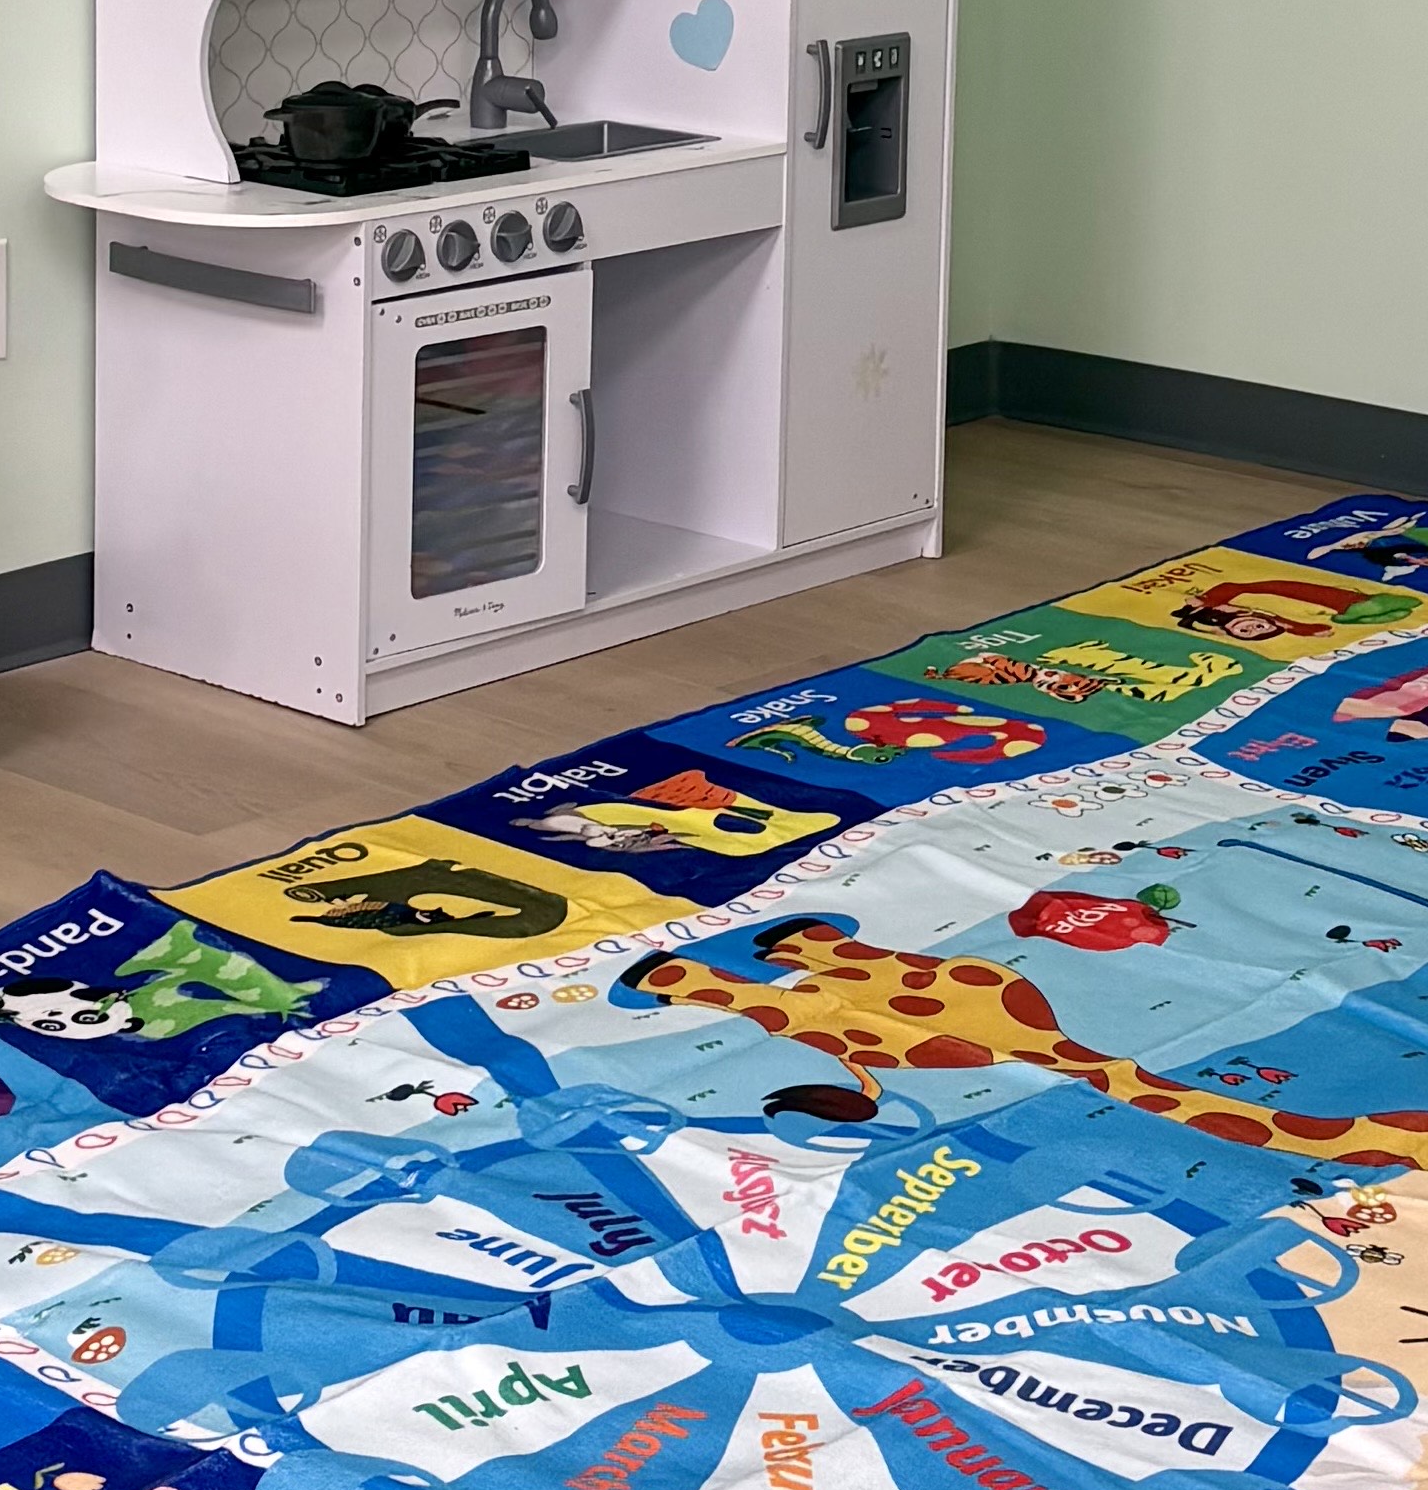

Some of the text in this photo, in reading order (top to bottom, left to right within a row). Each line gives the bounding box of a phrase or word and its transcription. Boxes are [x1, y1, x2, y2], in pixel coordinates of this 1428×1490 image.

[962, 627, 1043, 652] Tige
[730, 688, 838, 725] Snake
[256, 842, 370, 885] Quail
[436, 1228, 595, 1288] June
[921, 1229, 1132, 1304] Octoer
[412, 1362, 593, 1431] April
